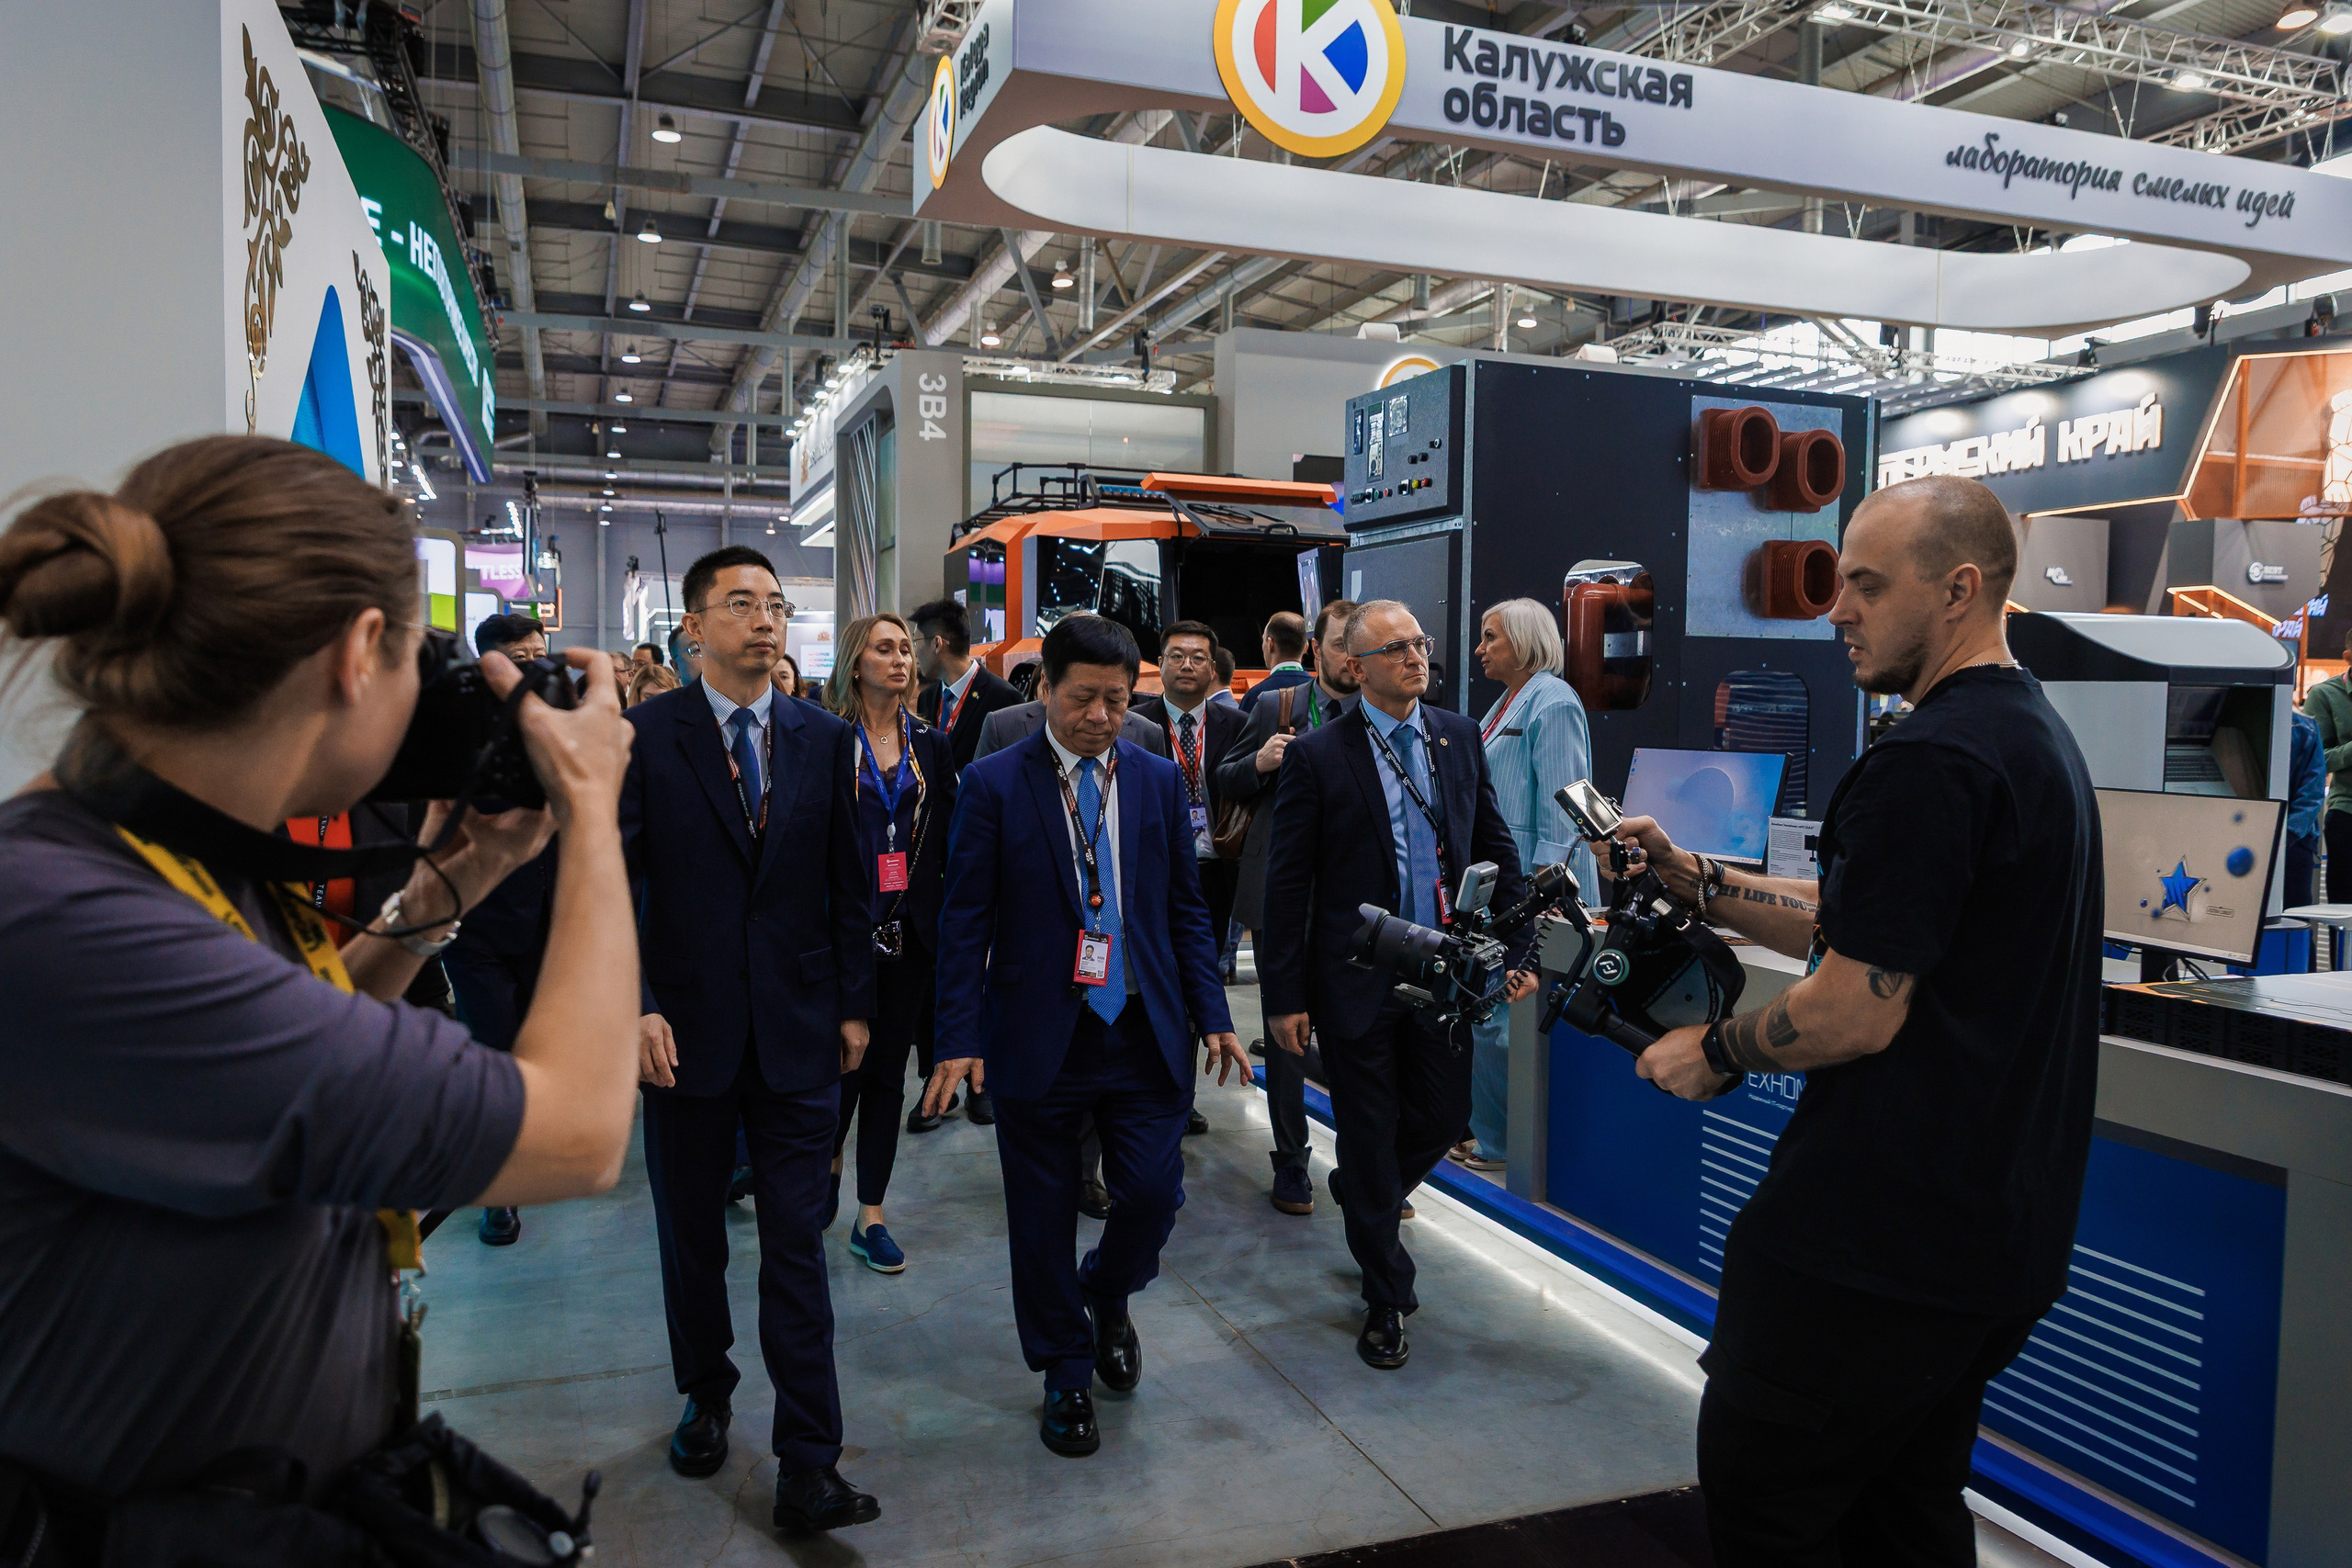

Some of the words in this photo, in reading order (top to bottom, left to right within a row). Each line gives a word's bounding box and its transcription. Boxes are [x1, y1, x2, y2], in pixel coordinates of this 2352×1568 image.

[960, 58, 989, 119] Region
[1443, 25, 1694, 109] Калужская
[1443, 81, 1626, 147] область
[1945, 131, 2123, 200] лаборатория
[2132, 170, 2232, 209] смелых
[2235, 184, 2297, 228] идей
[2057, 392, 2162, 463] КРАЙ
[1743, 887, 1777, 906] LIFE
[1780, 894, 1809, 911] YOU
